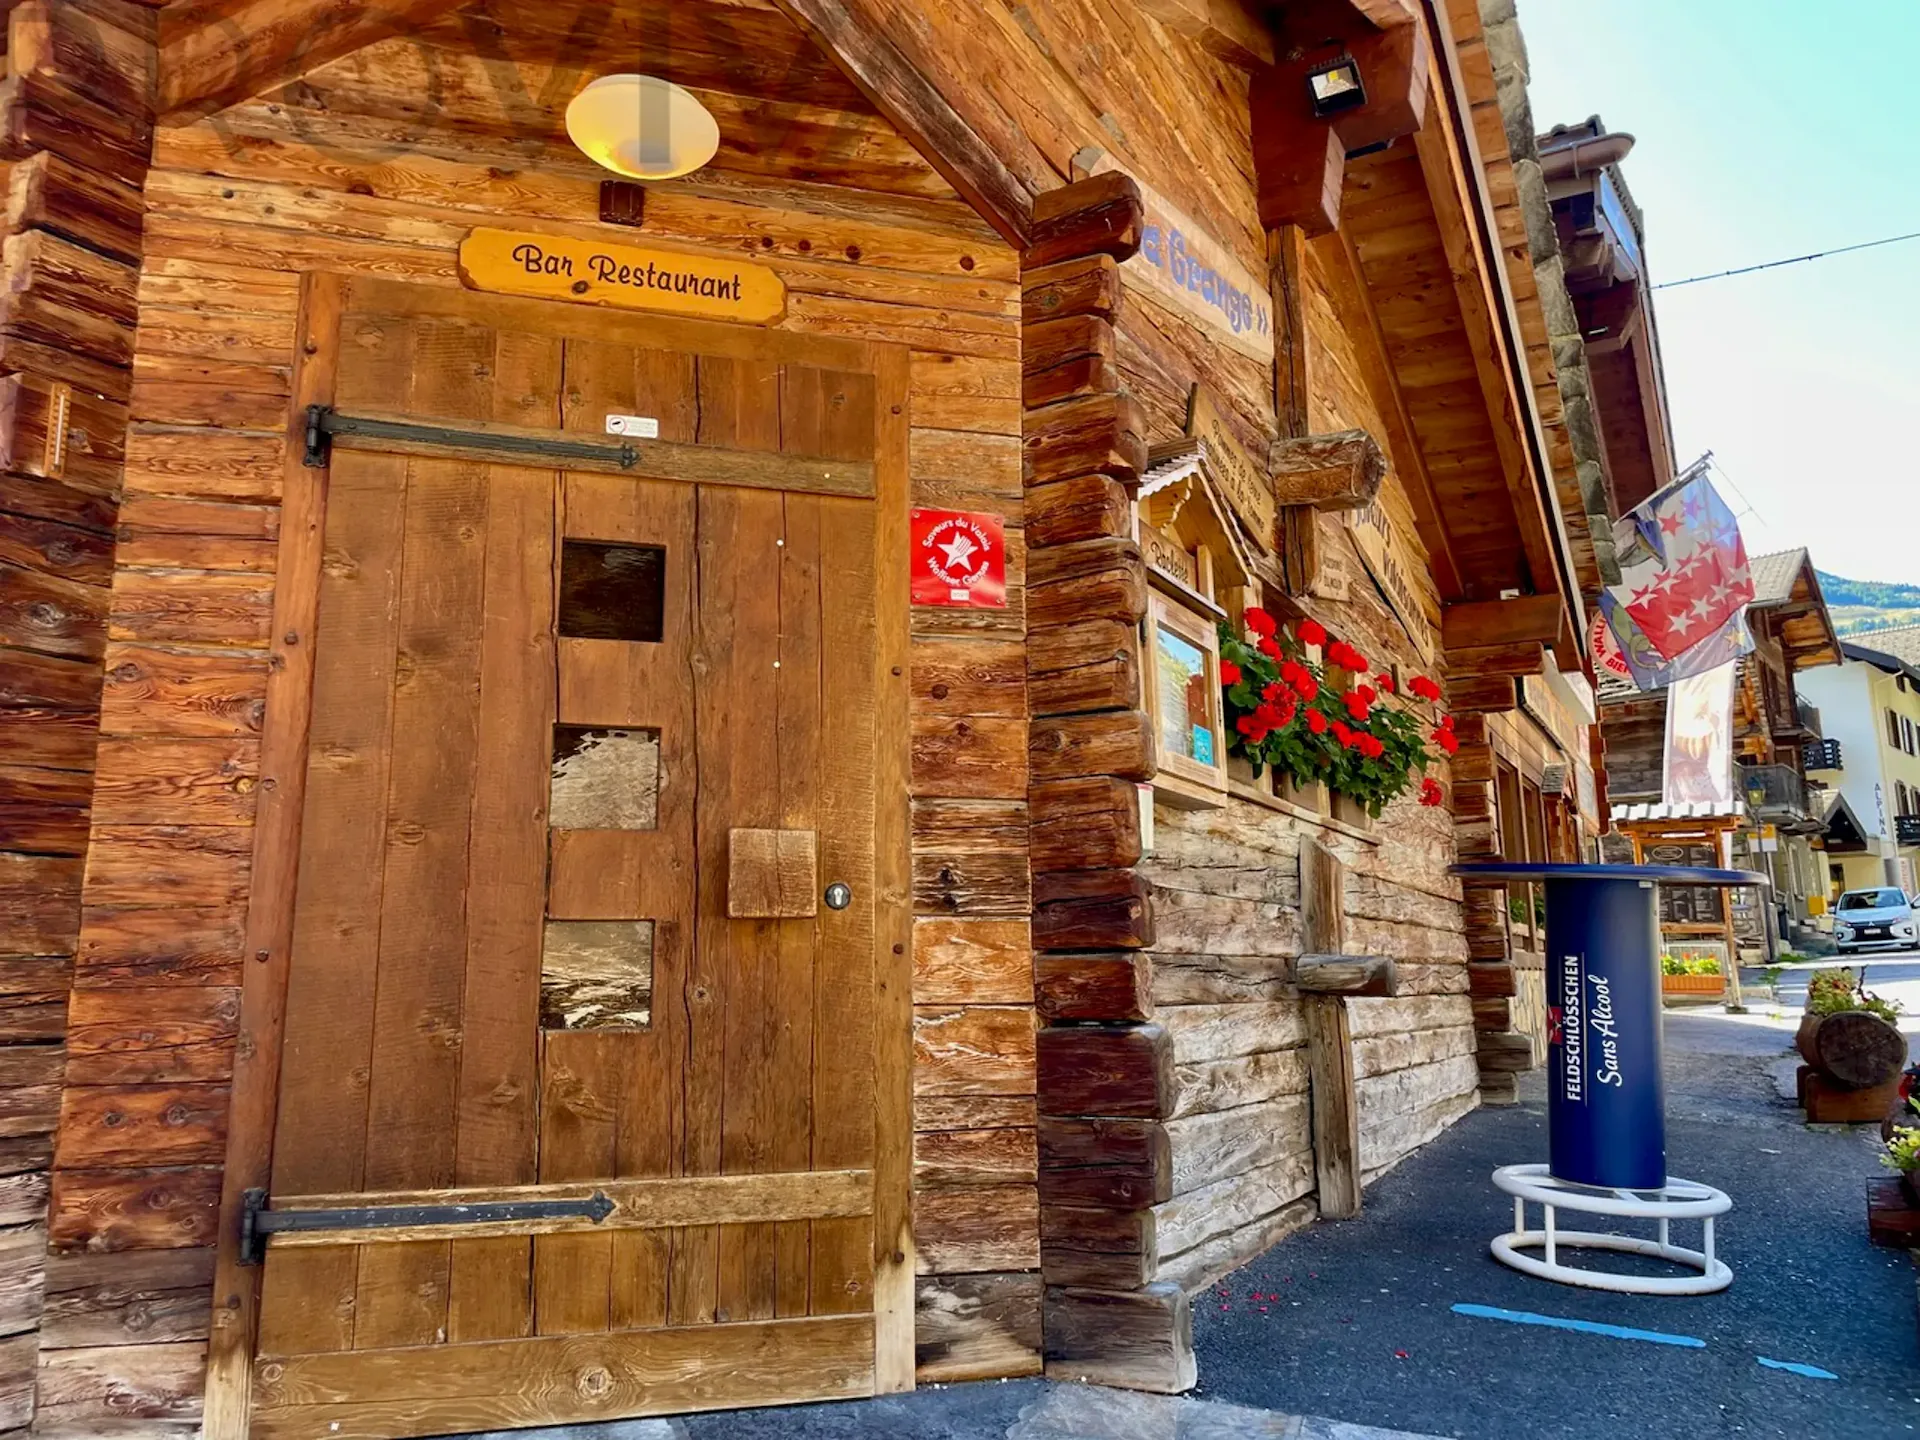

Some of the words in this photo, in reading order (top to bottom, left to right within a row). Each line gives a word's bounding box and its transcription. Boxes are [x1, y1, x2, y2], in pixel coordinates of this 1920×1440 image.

[512, 244, 573, 277] Bar
[588, 254, 742, 302] Restaurant
[1140, 224, 1163, 268] a
[922, 519, 955, 548] Saveurs
[955, 516, 969, 529] du
[970, 521, 992, 552] Valais
[1874, 782, 1887, 836] ALPINA
[1562, 955, 1582, 1101] FELDSCHLÖSSCHEN
[1587, 974, 1619, 1038] Alcool
[1596, 1040, 1623, 1088] Sans
